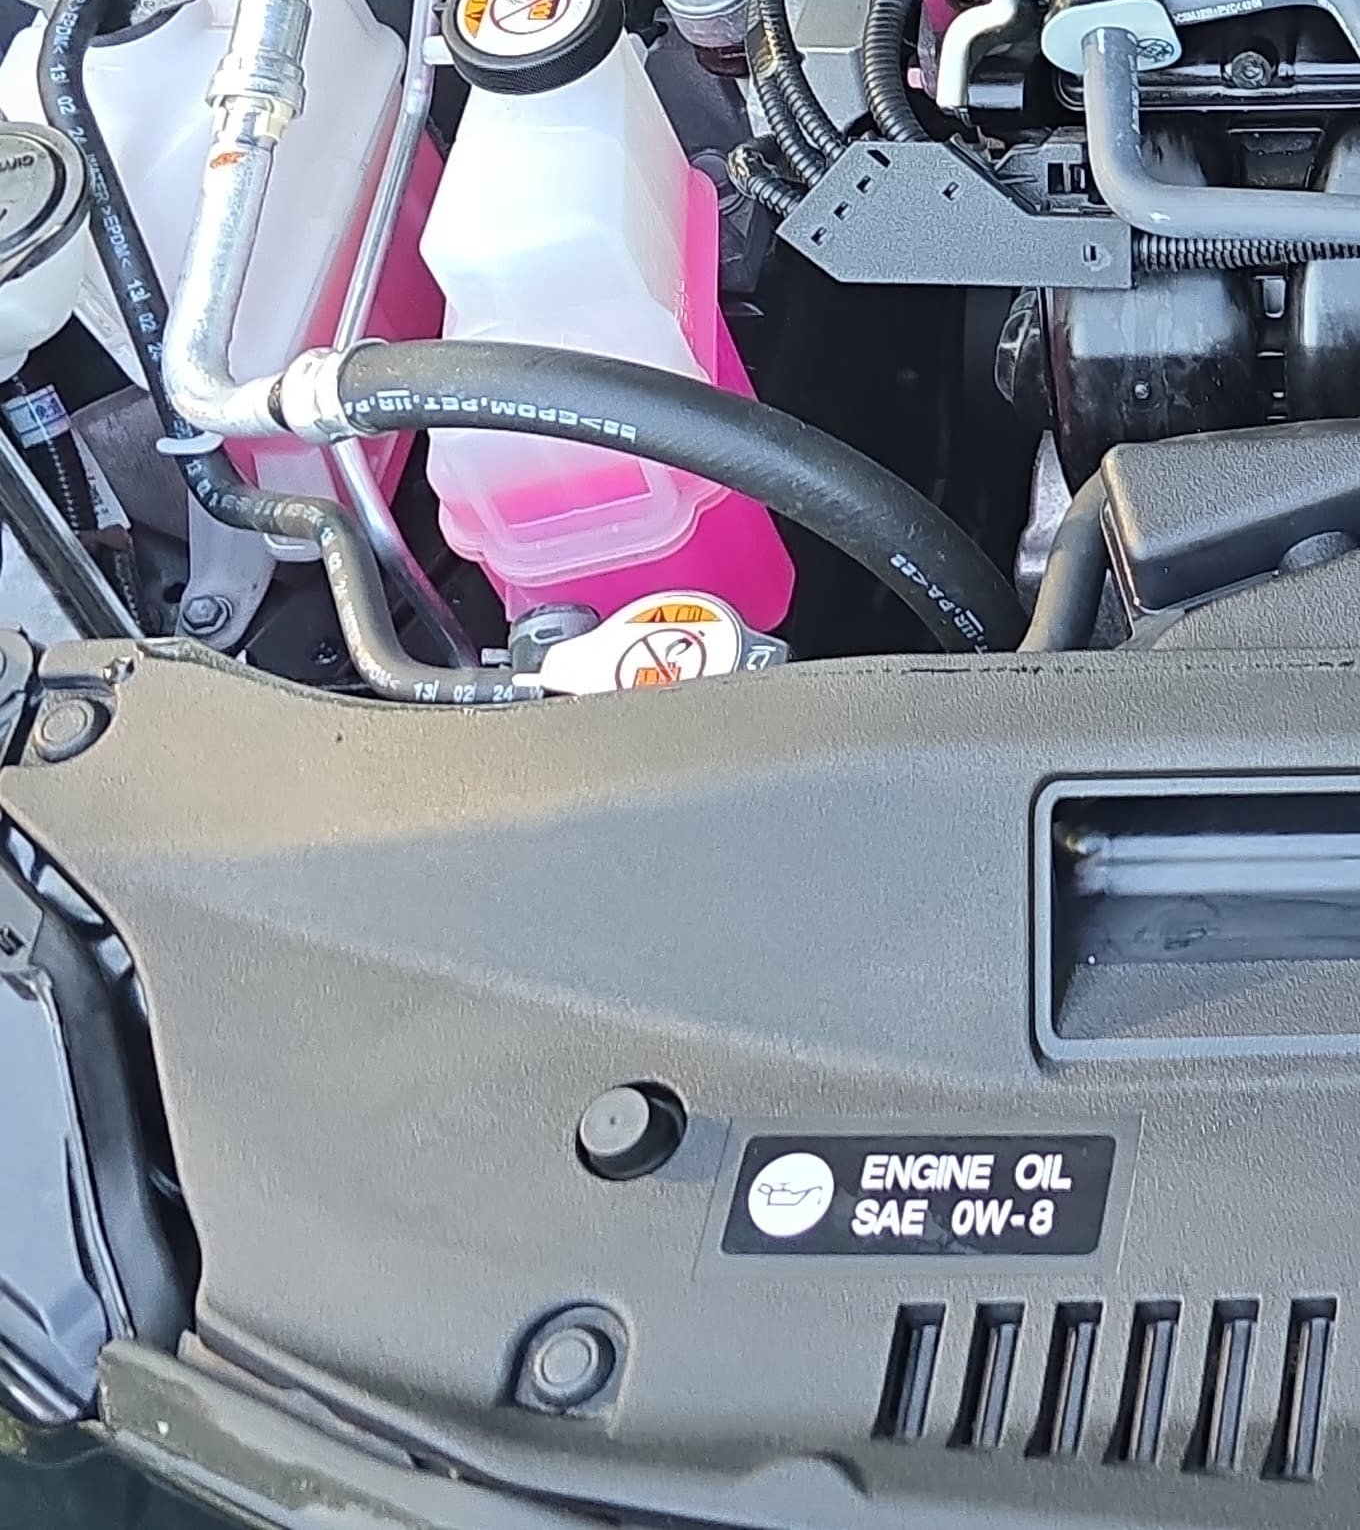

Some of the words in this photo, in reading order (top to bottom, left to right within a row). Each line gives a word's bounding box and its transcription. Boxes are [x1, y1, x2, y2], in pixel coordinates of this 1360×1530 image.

[860, 1153, 995, 1192] ENGINE
[1015, 1153, 1072, 1192] OIL
[851, 1198, 928, 1237] SAE
[951, 1199, 1055, 1237] 0W-8
